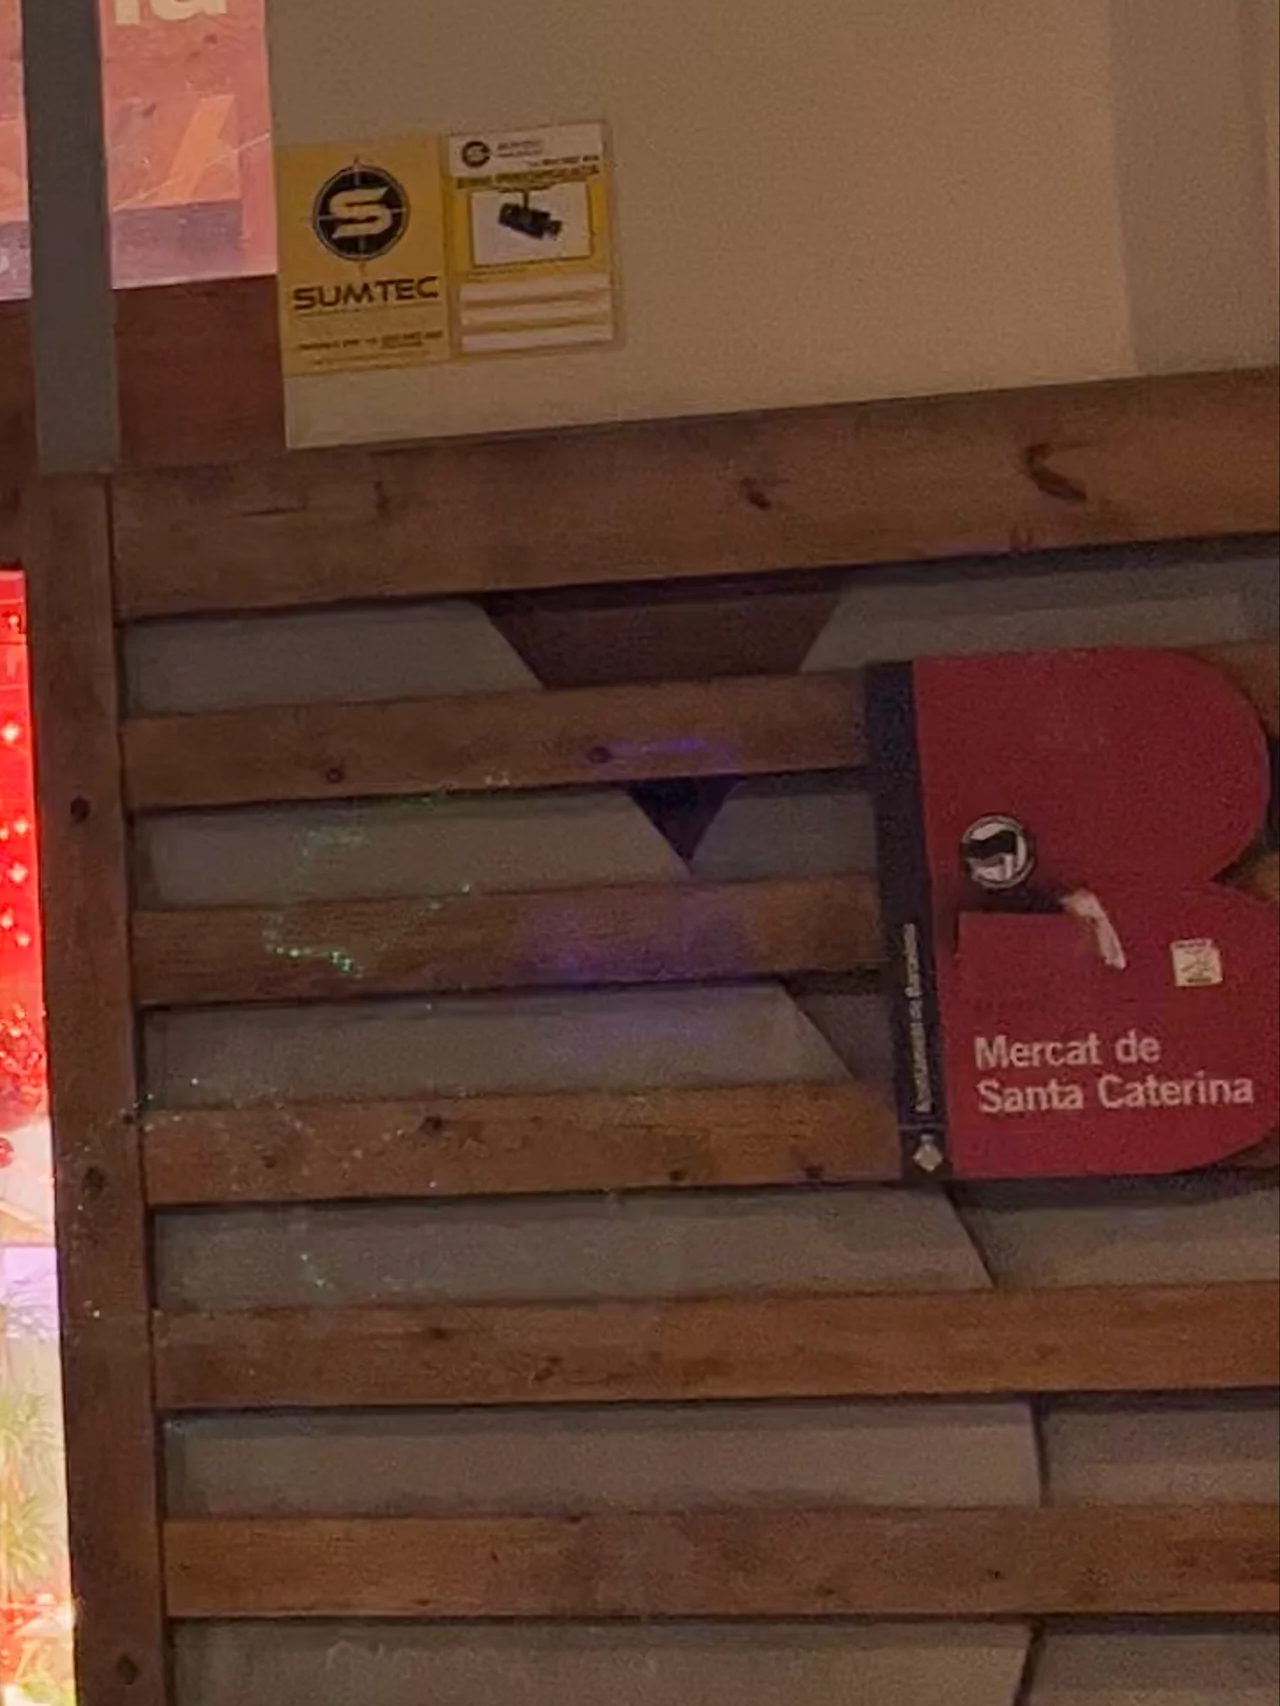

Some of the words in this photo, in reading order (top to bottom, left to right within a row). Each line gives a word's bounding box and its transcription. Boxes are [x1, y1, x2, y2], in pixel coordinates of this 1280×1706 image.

[293, 276, 439, 311] SUMTEC
[974, 1032, 1102, 1070] Mercat
[1115, 1029, 1161, 1064] de
[976, 1079, 1085, 1114] Santa
[1097, 1071, 1255, 1109] Caterina
